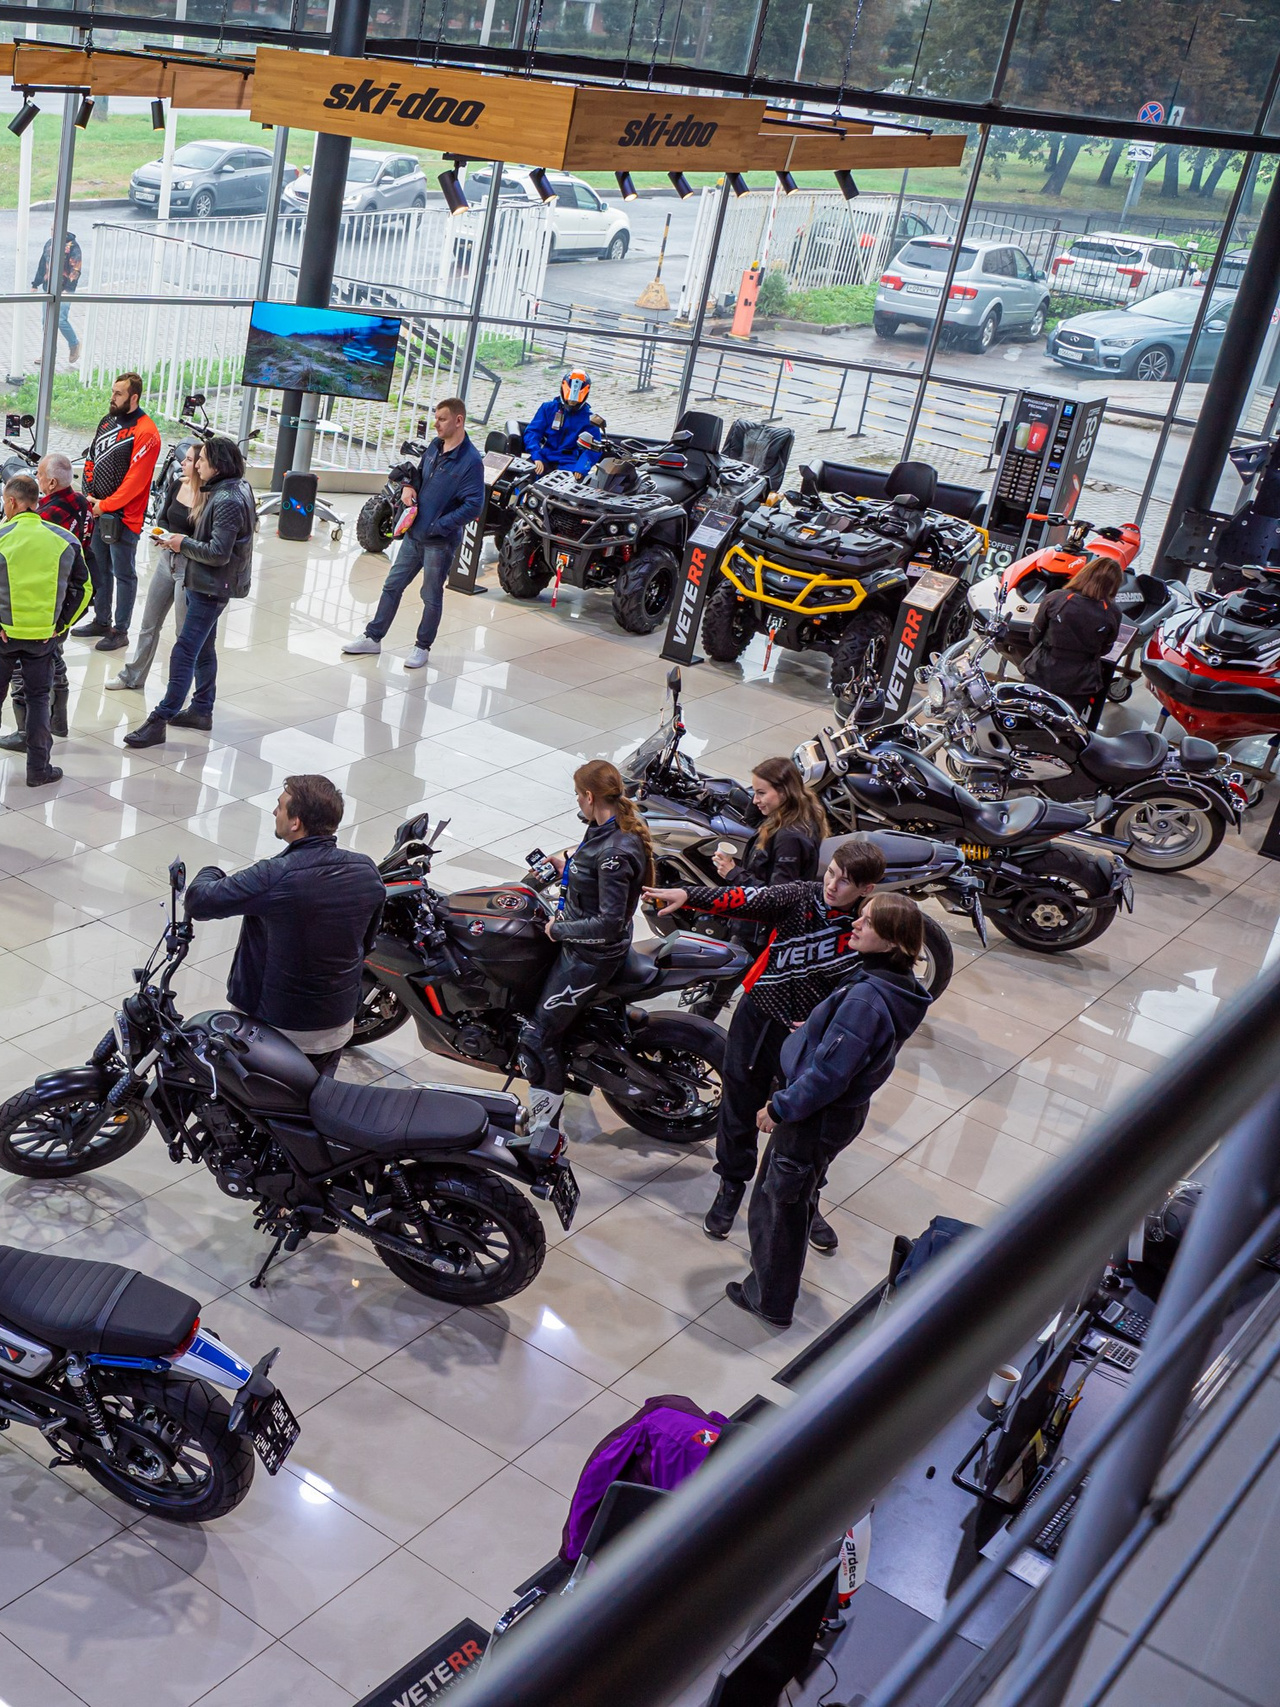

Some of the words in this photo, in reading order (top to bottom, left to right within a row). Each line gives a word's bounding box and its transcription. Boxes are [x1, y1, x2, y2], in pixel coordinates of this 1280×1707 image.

[323, 79, 486, 127] ski-doo
[618, 113, 718, 148] ski-doo
[1076, 437, 1092, 459] GO
[1083, 416, 1098, 437] TO
[458, 517, 480, 577] VETE
[985, 548, 1012, 567] TO
[673, 547, 706, 647] VETERR
[884, 607, 924, 712] VETERR
[777, 933, 852, 969] VETER
[845, 1540, 857, 1589] ardeca
[391, 1639, 483, 1707] VETERR
